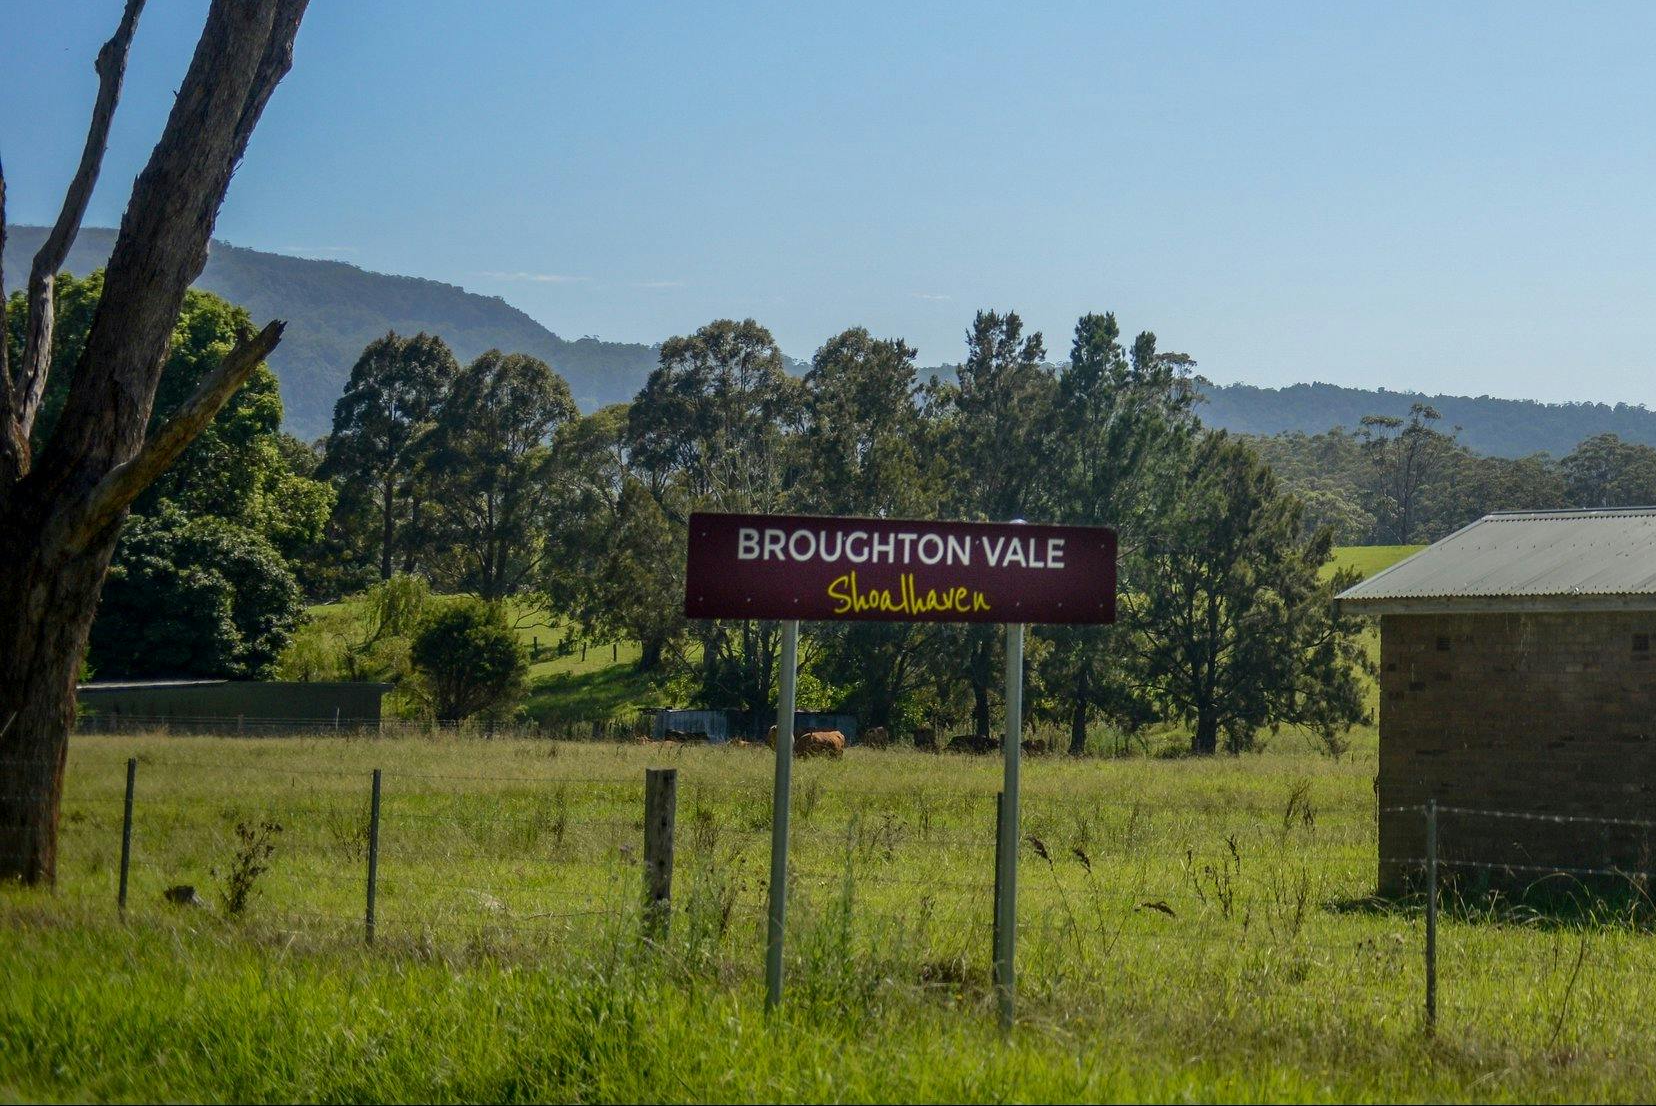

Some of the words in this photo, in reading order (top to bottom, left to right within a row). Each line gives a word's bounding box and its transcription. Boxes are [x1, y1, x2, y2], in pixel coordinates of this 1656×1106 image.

[737, 528, 969, 566] BROUGHTON
[981, 536, 1066, 569] VALE
[828, 570, 991, 615] Shoalhaven
